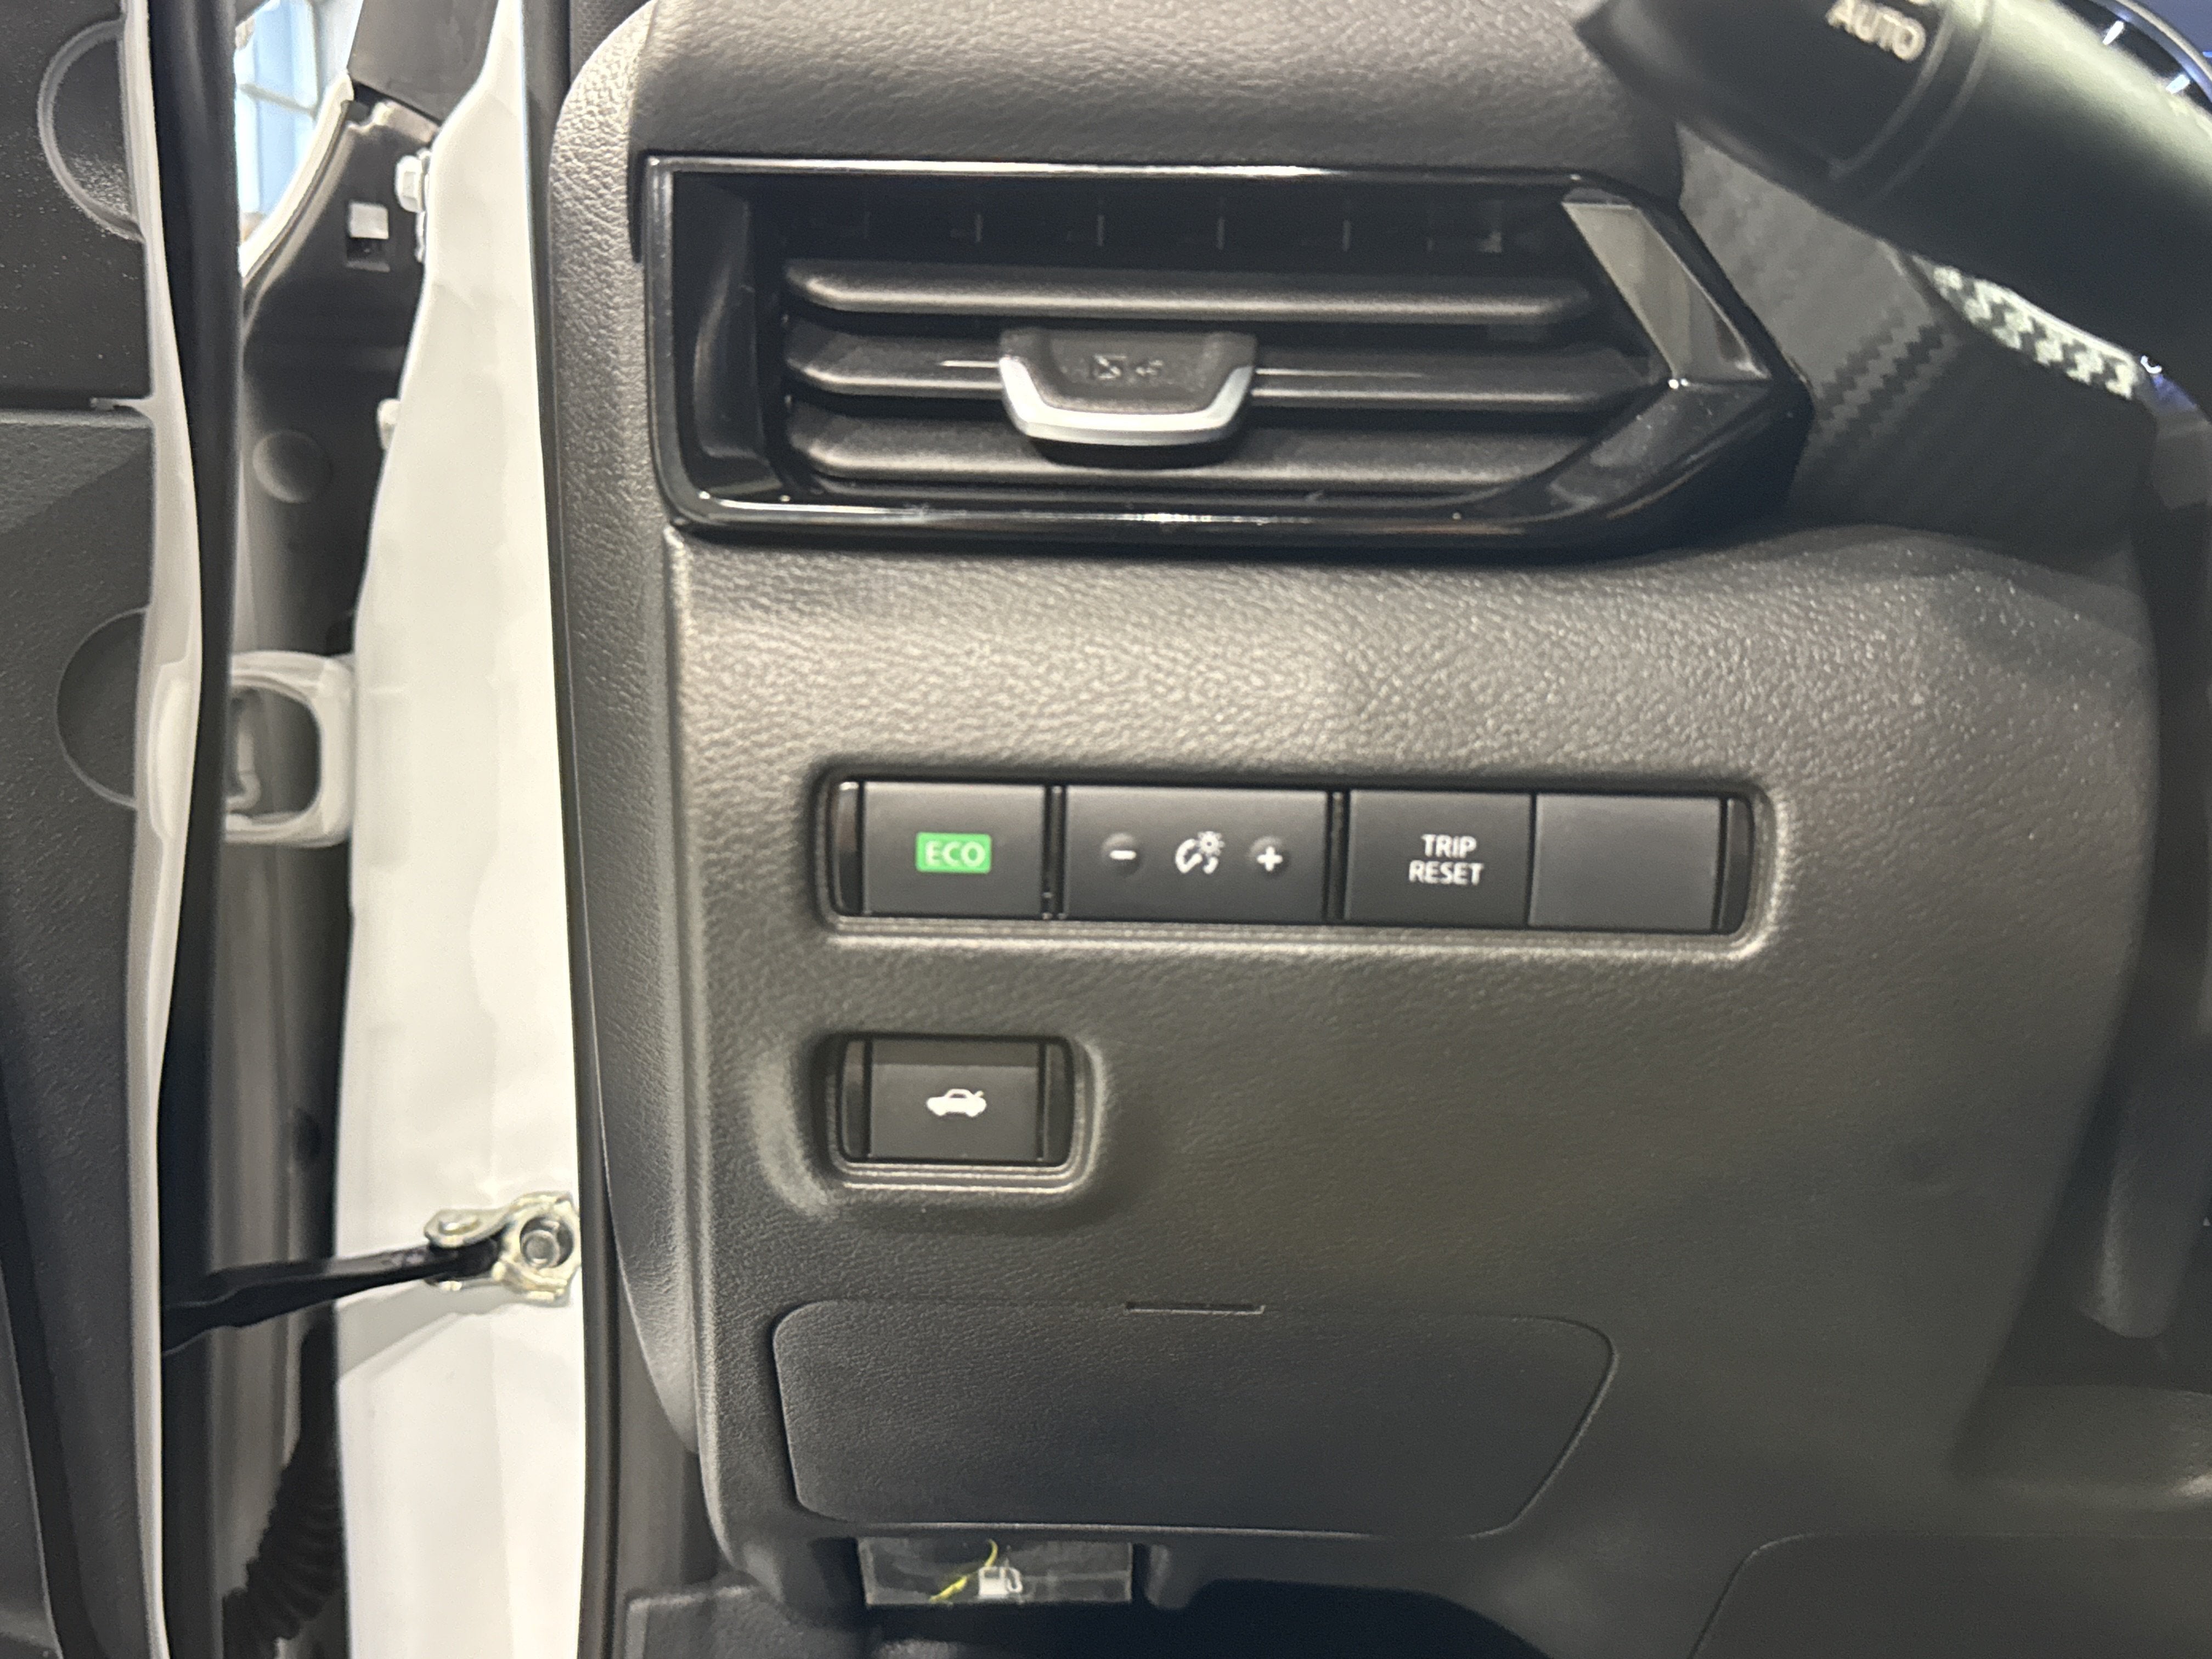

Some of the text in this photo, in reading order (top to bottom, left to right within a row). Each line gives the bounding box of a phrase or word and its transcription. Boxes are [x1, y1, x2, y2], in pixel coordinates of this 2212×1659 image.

[1826, 0, 1926, 63] AUTO
[925, 840, 986, 868] ECO
[1421, 833, 1477, 859] TRIP
[1408, 860, 1485, 886] RESET
